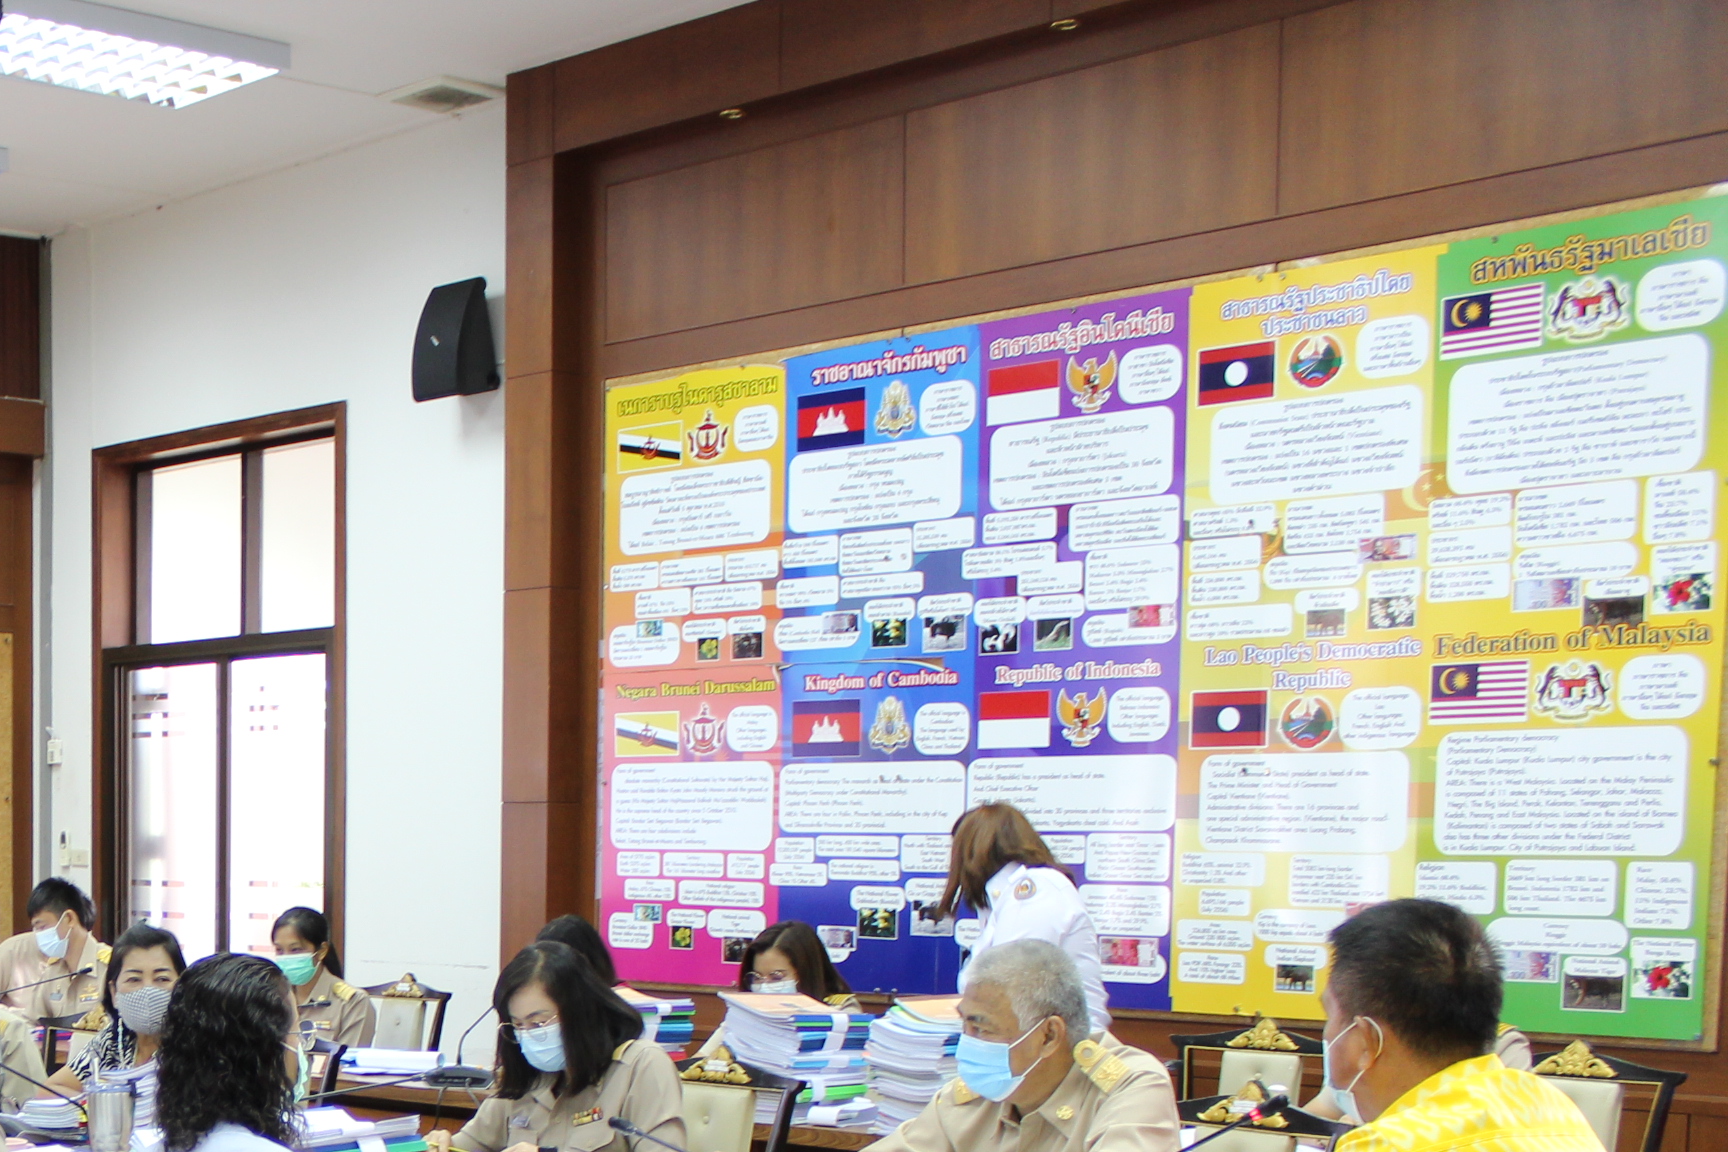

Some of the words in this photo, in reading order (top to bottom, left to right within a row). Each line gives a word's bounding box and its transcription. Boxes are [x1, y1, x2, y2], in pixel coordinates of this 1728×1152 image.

[1260, 306, 1368, 338] ประชาชนลาว
[1204, 648, 1239, 667] Lao
[1242, 641, 1312, 668] People's
[1316, 638, 1422, 661] Democratic
[1434, 630, 1558, 659] Federation
[1566, 625, 1593, 651] of
[1599, 619, 1714, 654] Malaysia
[804, 672, 866, 694] Kingdom
[868, 672, 885, 688] of
[887, 669, 959, 689] Cambodia
[995, 663, 1062, 688] Republic
[1064, 661, 1085, 682] of
[1085, 658, 1161, 681] Indonesia
[1273, 669, 1352, 692] Republic
[616, 683, 659, 701] Negara
[660, 681, 701, 698] Brunei
[704, 677, 776, 695] Darussalam
